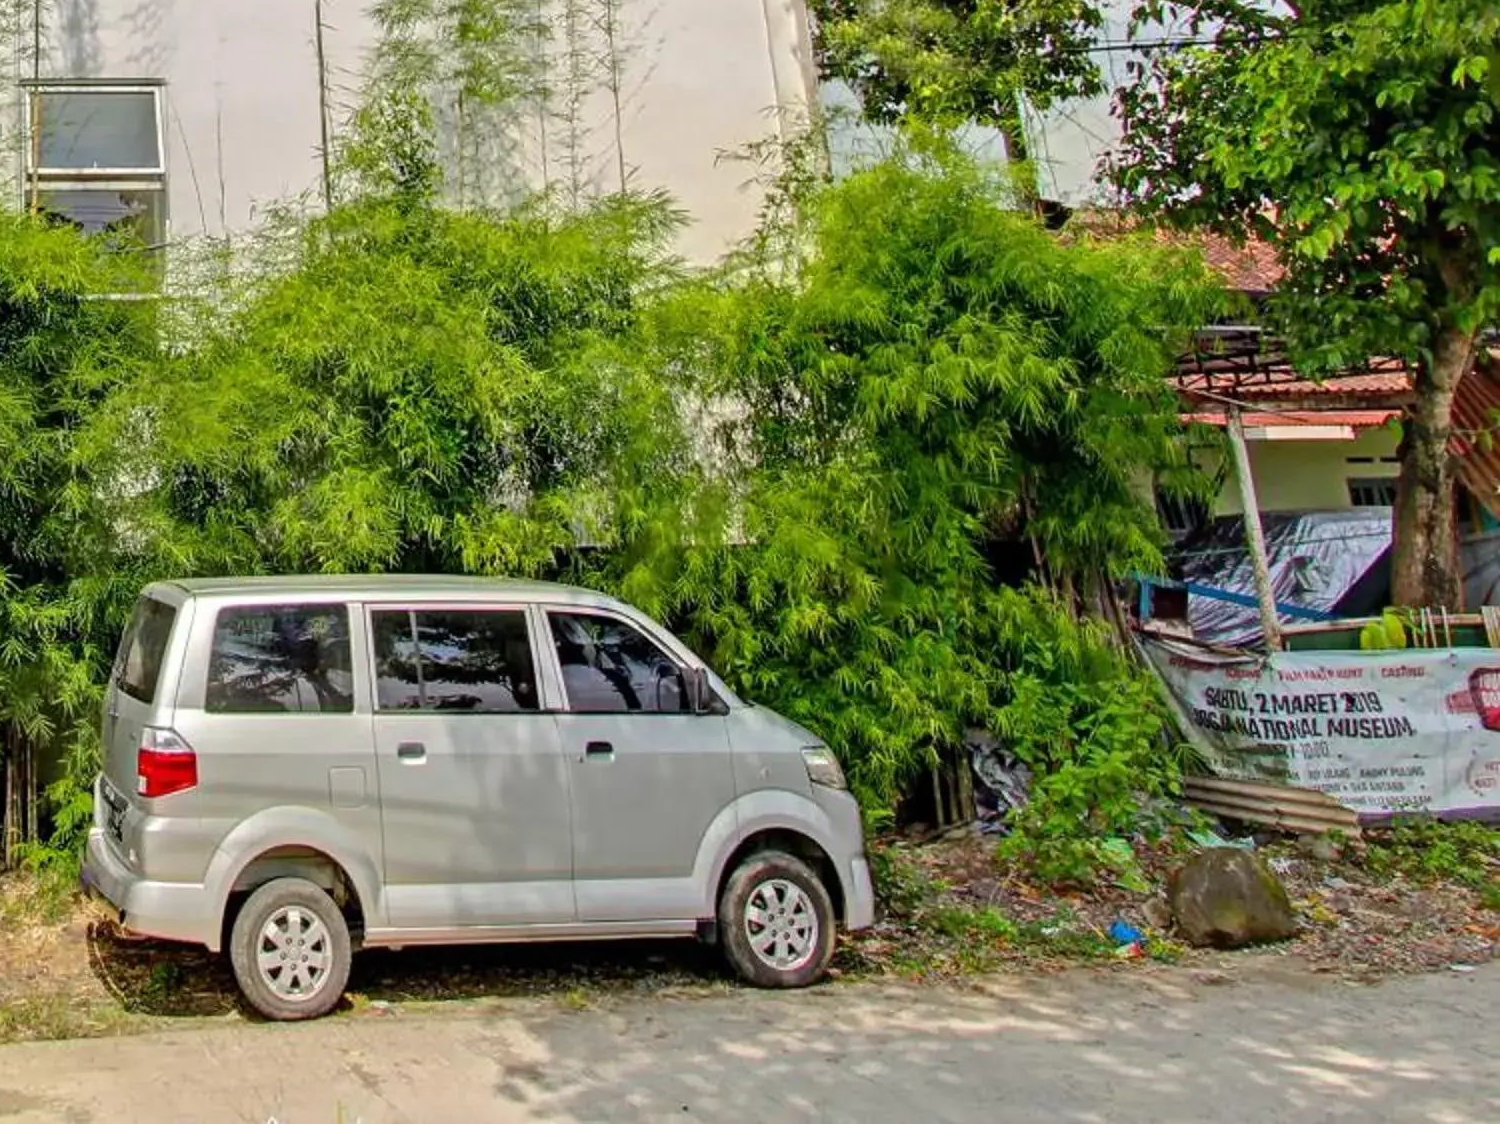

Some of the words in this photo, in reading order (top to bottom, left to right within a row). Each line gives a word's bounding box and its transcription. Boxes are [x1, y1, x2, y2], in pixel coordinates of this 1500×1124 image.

[1255, 693, 1269, 713] 2
[1270, 693, 1337, 715] MARET
[1237, 716, 1322, 741] NATIONAL
